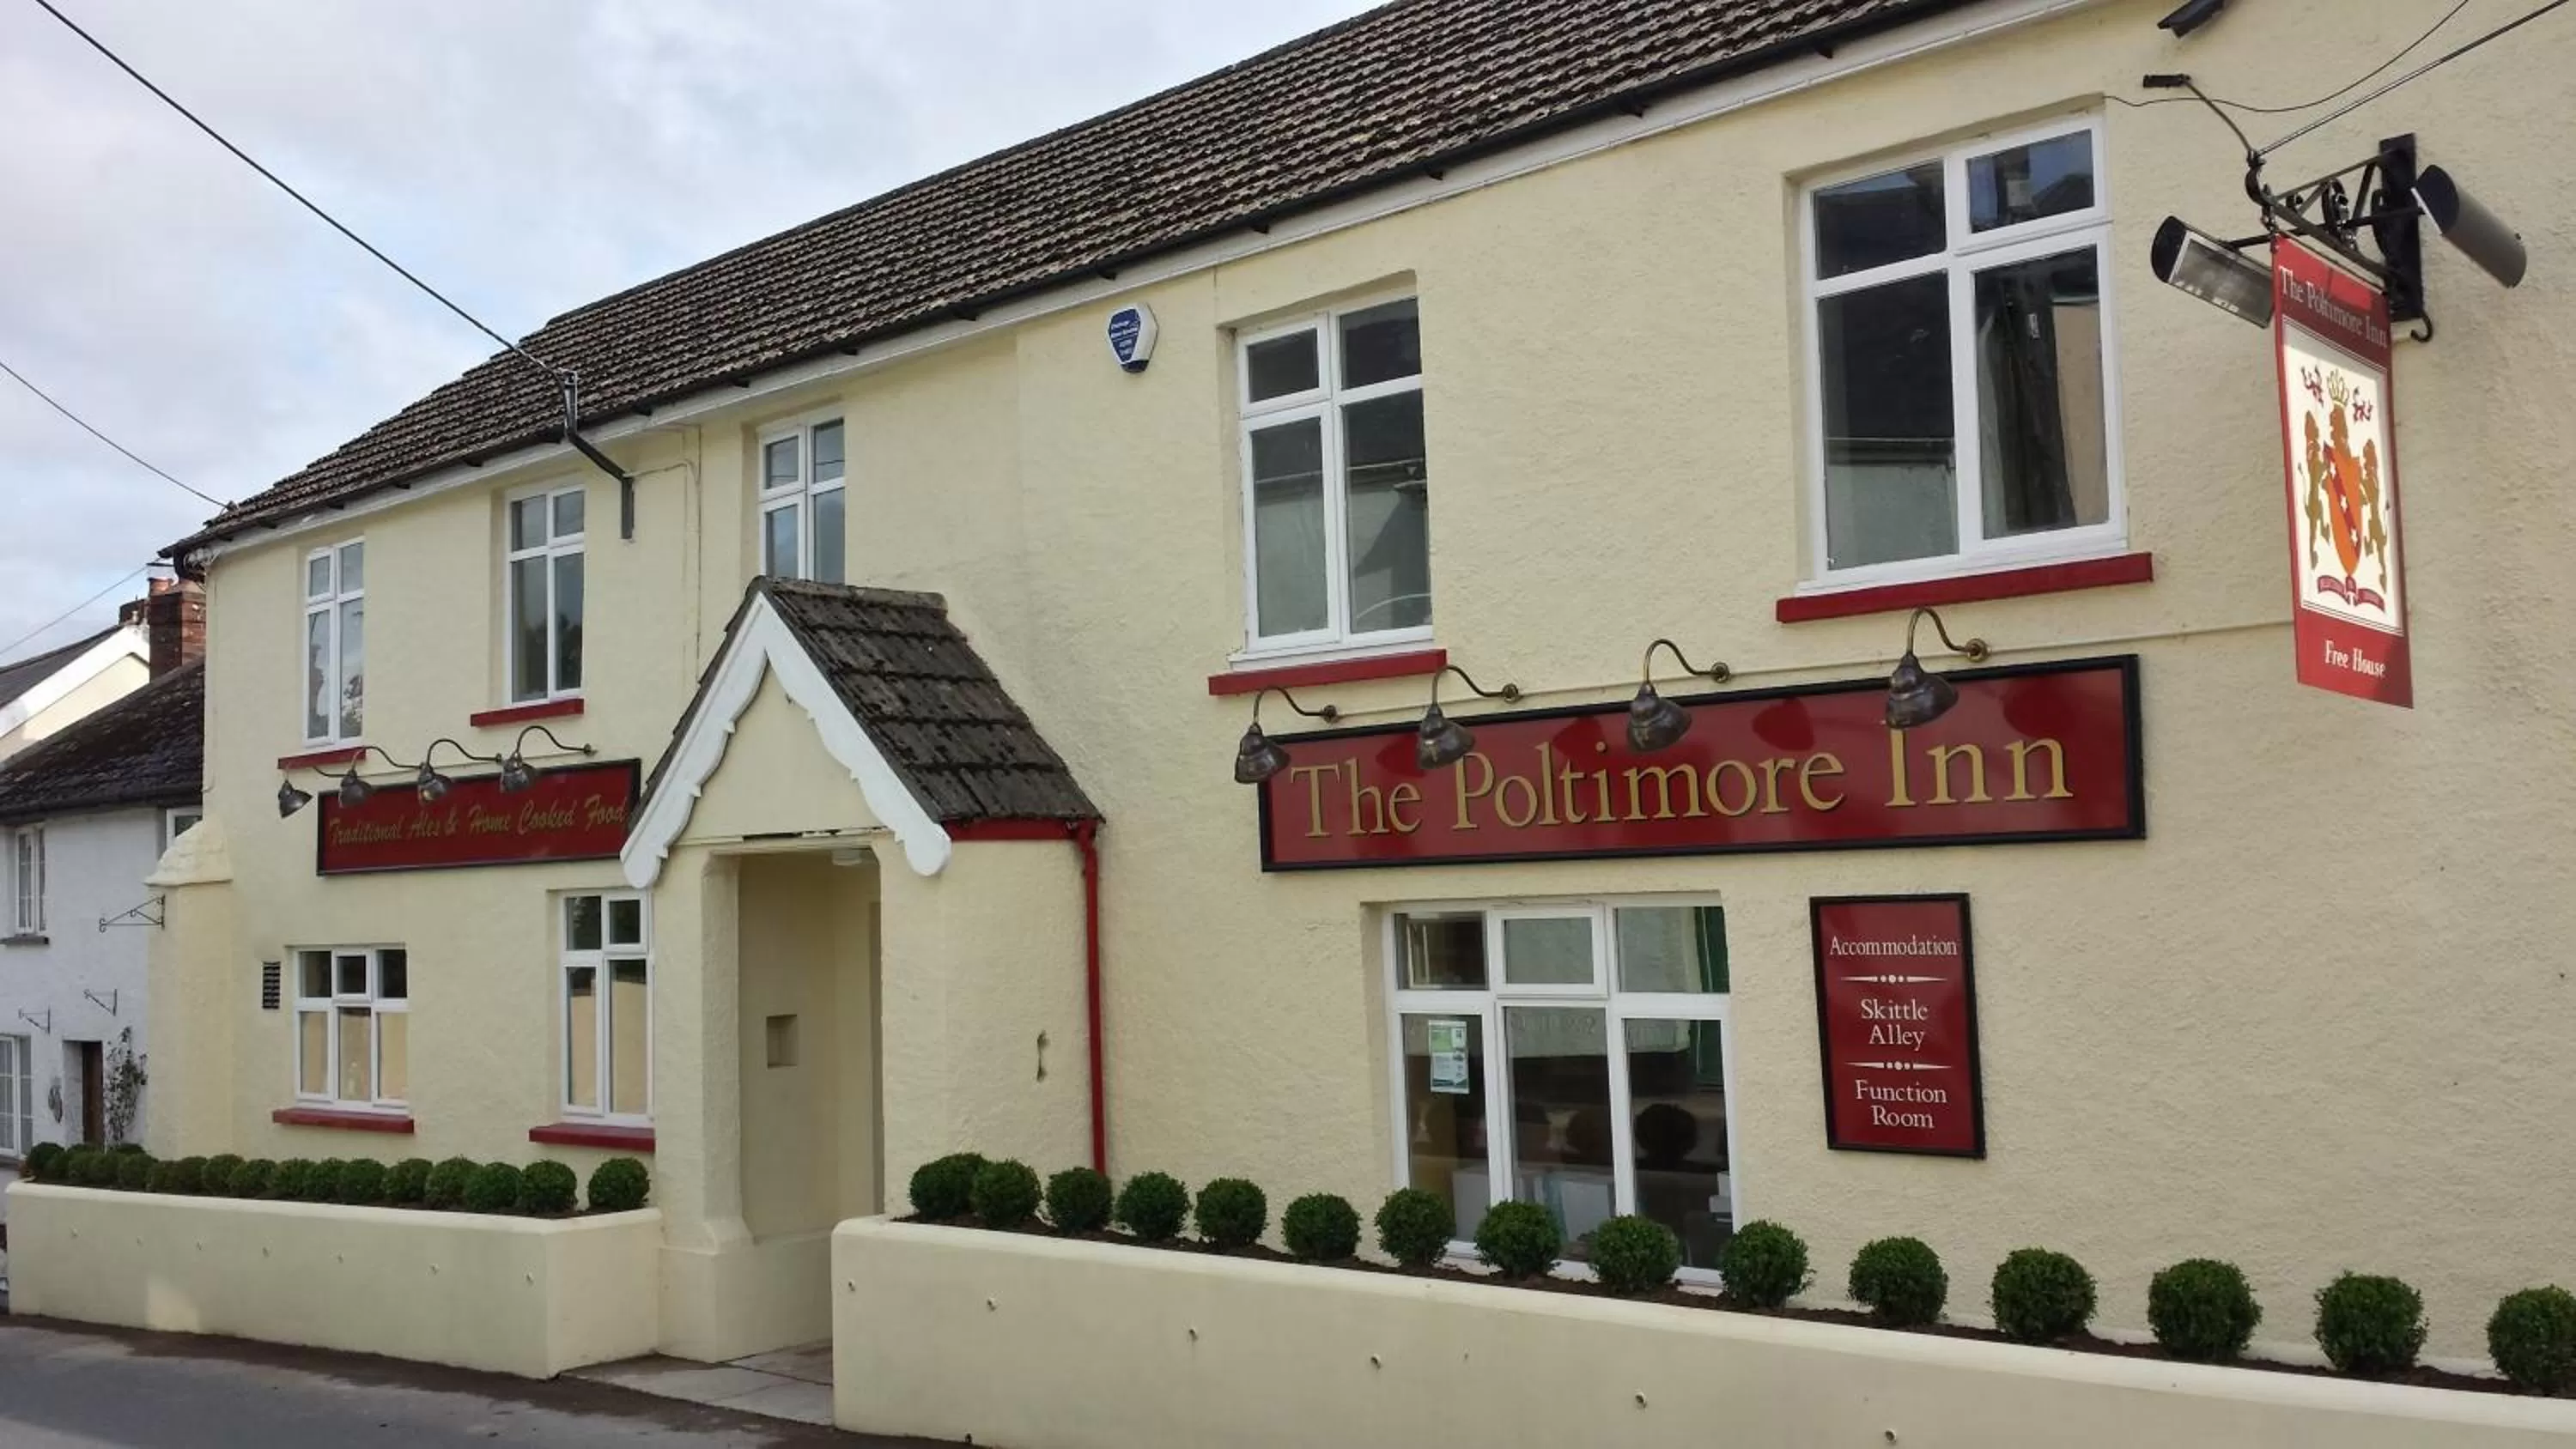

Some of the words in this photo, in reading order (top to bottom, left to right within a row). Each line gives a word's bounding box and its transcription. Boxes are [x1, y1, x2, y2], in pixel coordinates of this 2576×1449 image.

[2279, 264, 2305, 303] The
[2366, 315, 2388, 349] Inn
[2324, 639, 2349, 669] Free
[2352, 647, 2386, 678] House
[1290, 756, 1423, 838] The
[1452, 740, 1844, 830] Poltimore
[1885, 729, 2074, 807] Inn
[329, 815, 404, 846] Traditional
[406, 810, 441, 840] Ales
[445, 803, 458, 836] &
[467, 803, 511, 834] Home
[517, 797, 578, 835] Cooked
[584, 793, 628, 832] Food
[1830, 935, 1959, 956] Accommodation
[1860, 999, 1929, 1021] Skittle
[1868, 1024, 1926, 1052] Alley
[1855, 1078, 1948, 1104] Function
[1871, 1105, 1935, 1129] Room
